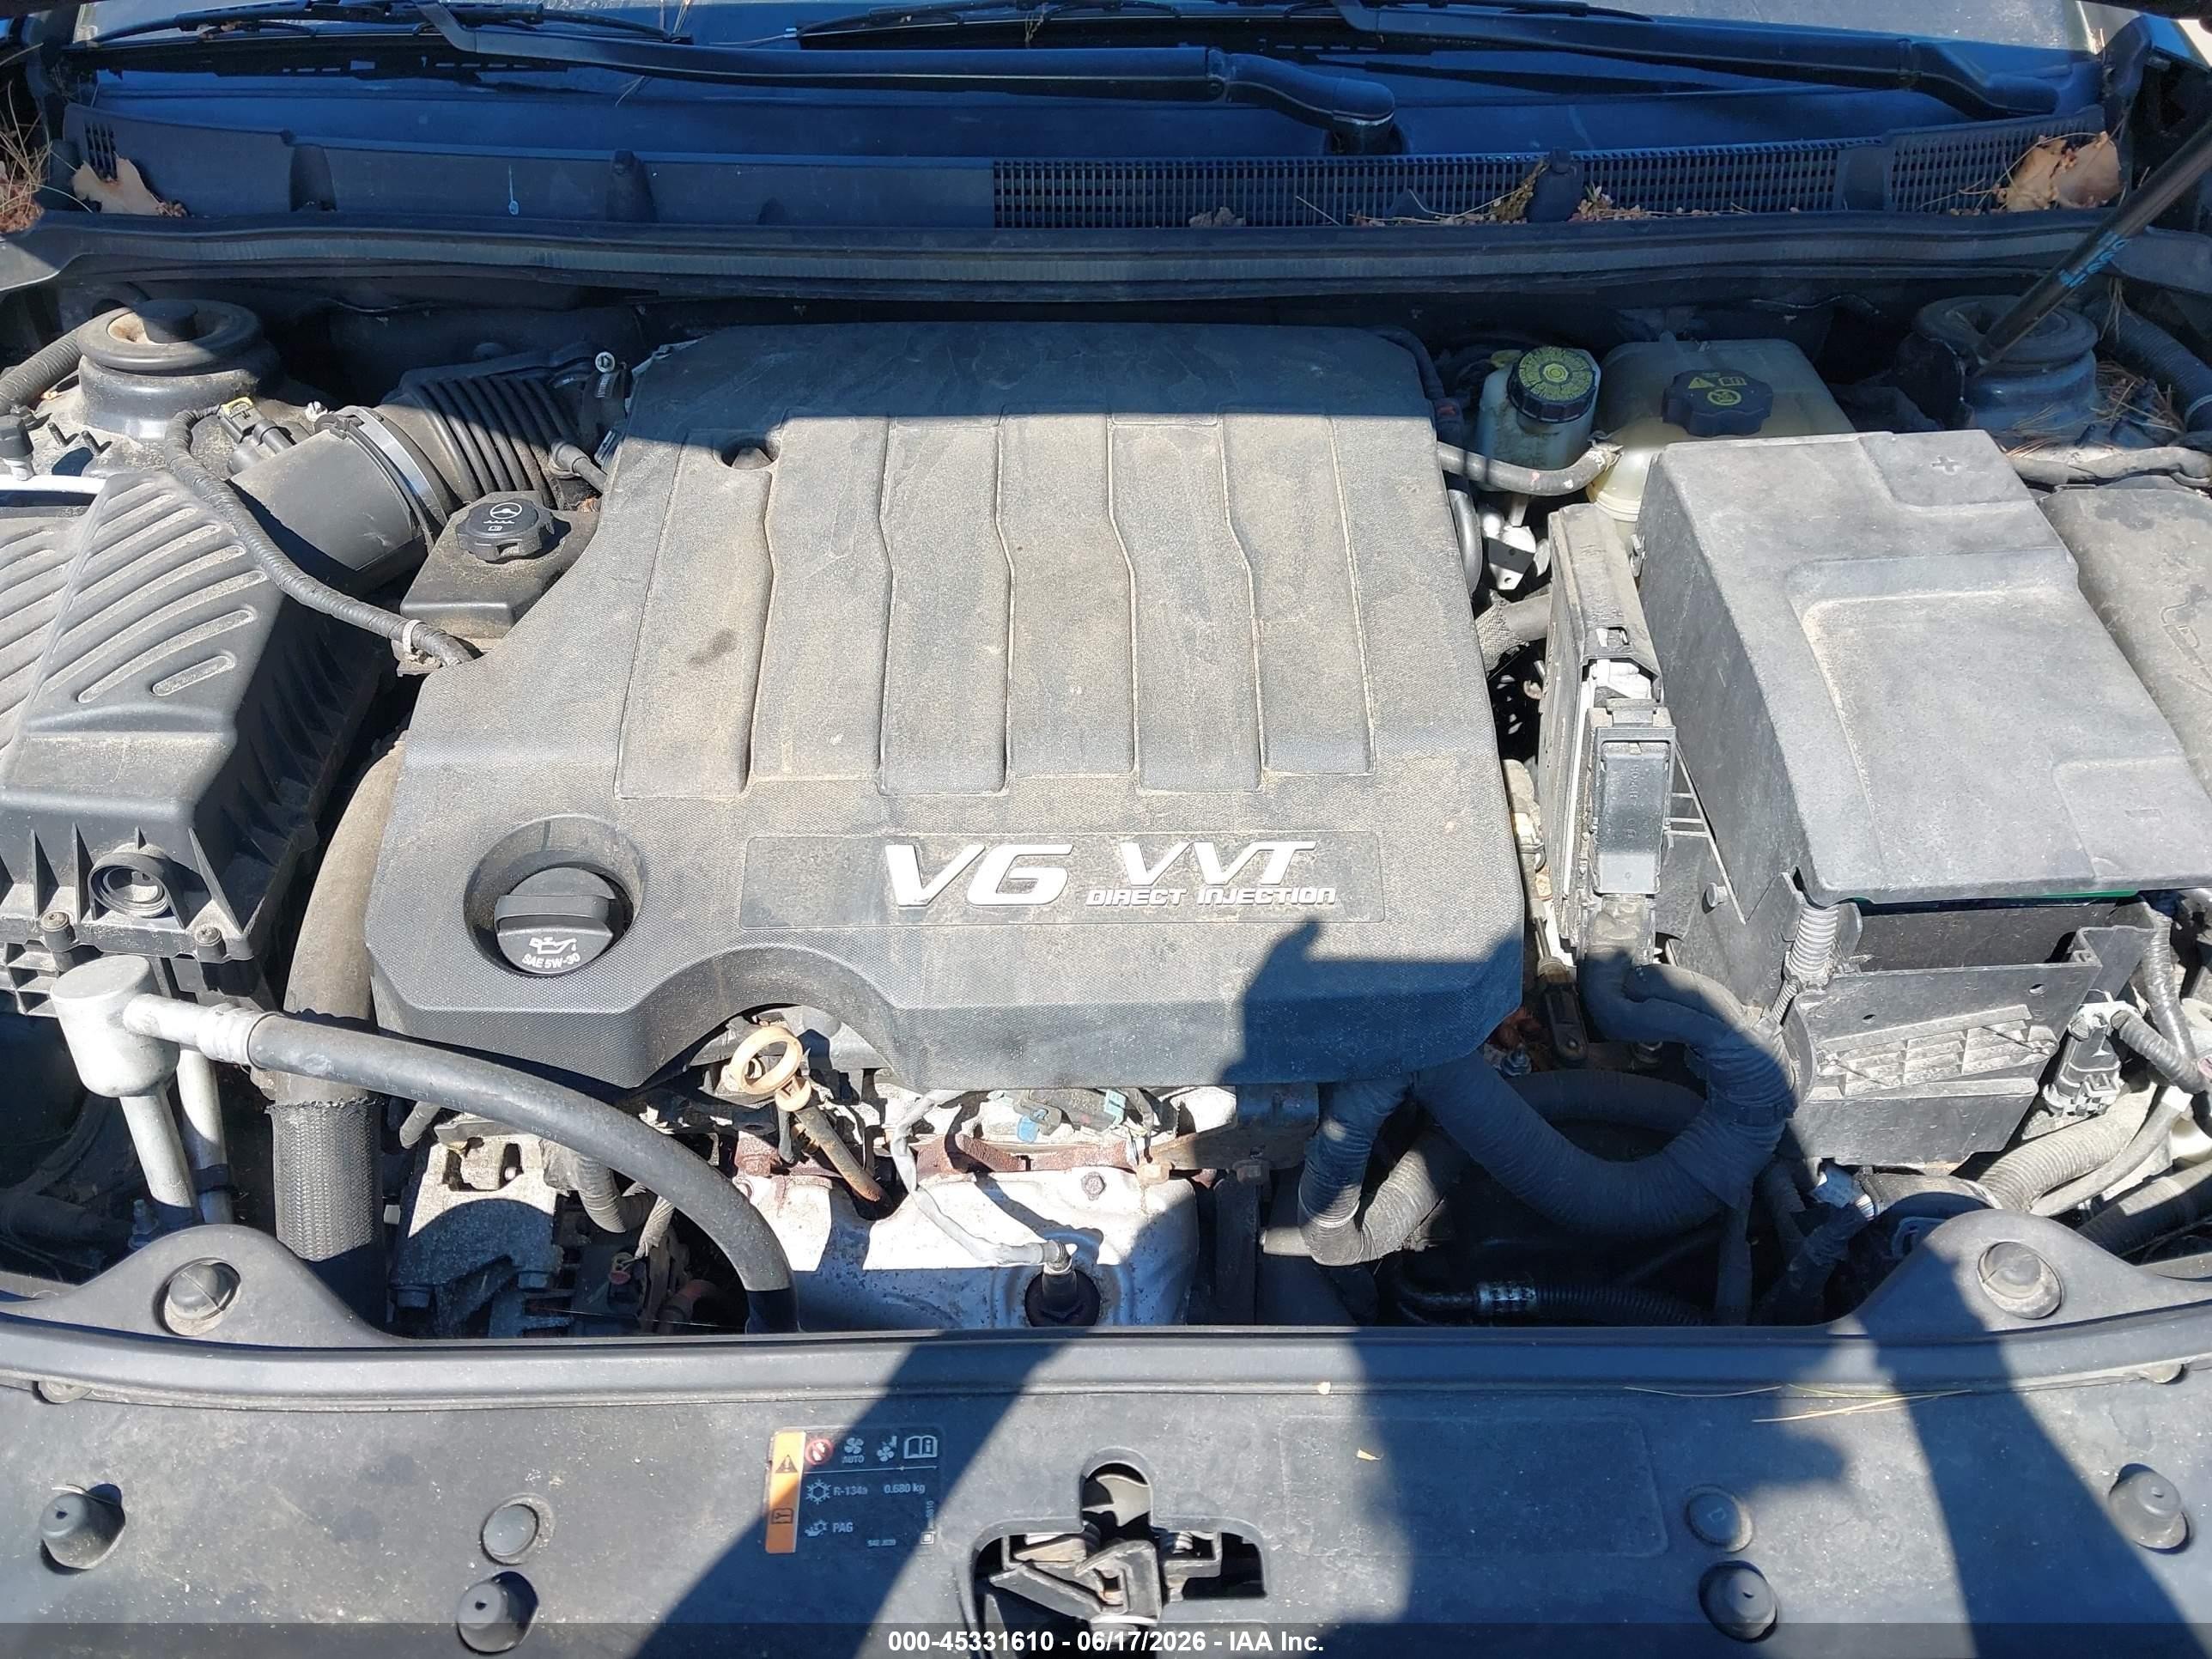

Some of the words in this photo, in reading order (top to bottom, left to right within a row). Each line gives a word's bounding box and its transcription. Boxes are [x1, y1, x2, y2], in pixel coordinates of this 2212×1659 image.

[885, 844, 1073, 907] V6
[1119, 841, 1318, 885] VVT
[1085, 888, 1188, 907] DIRECT
[1197, 887, 1337, 906] INJECTION
[522, 953, 544, 969] SAE
[544, 952, 581, 969] 5W-30
[842, 1455, 865, 1464] AUTO
[833, 1486, 868, 1496] R-134a
[884, 1483, 911, 1493] 0.680
[912, 1482, 926, 1494] kg
